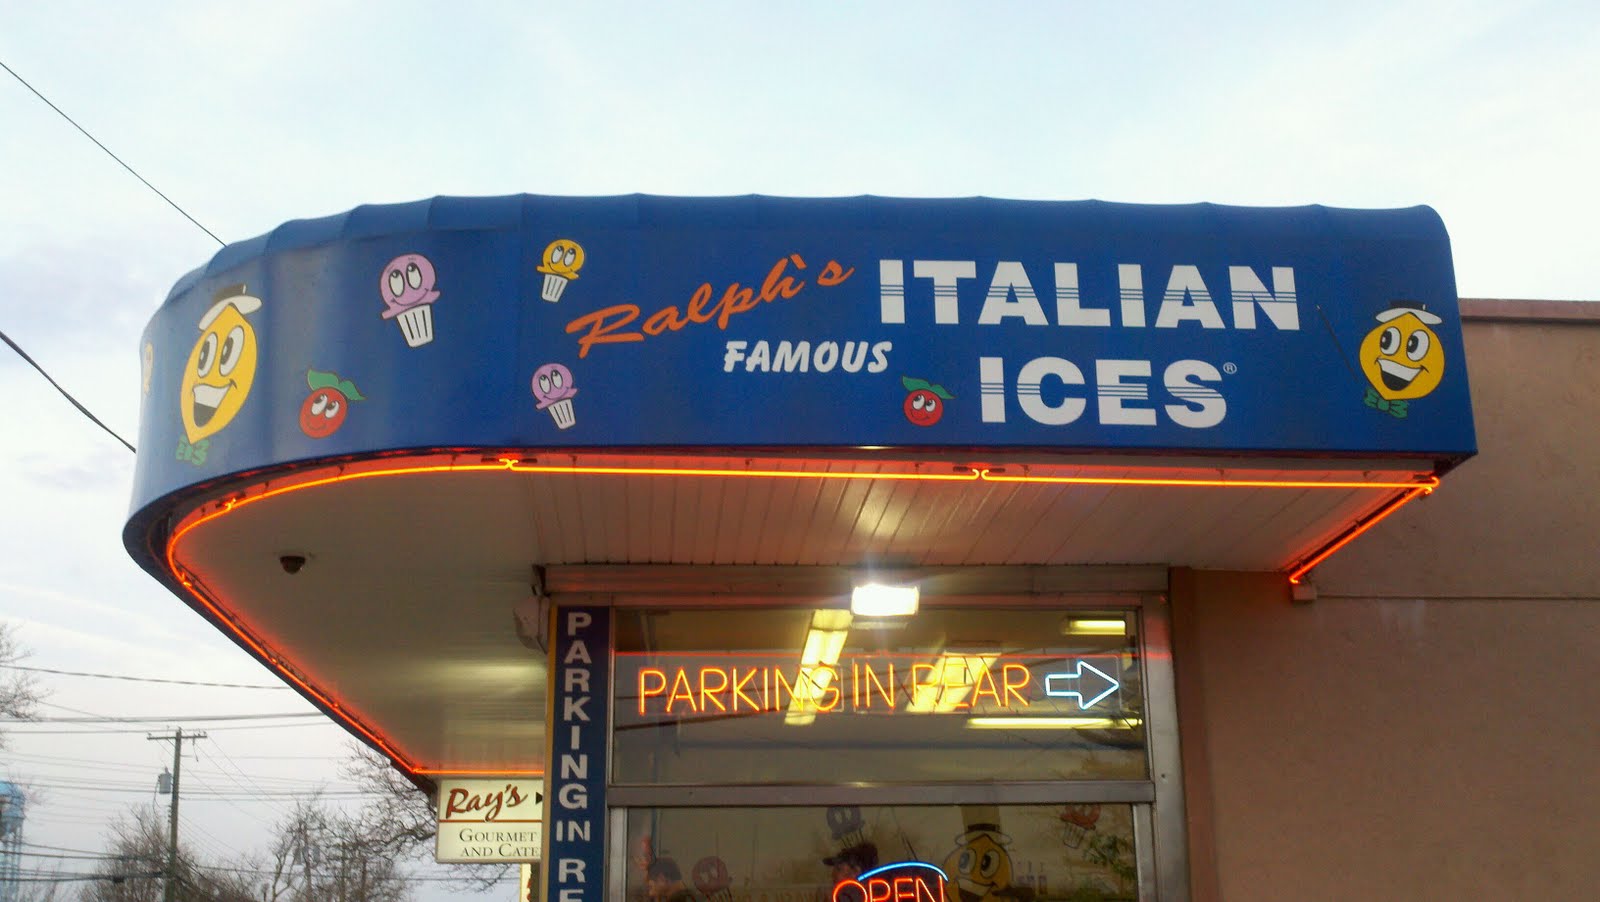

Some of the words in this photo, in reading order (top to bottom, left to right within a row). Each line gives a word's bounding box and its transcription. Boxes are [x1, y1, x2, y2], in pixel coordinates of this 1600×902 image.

[879, 259, 1300, 331] ITALIAN
[723, 340, 893, 374] FAMOUS
[638, 665, 840, 714] PARKING
[852, 662, 896, 708] IN
[911, 663, 1031, 708] REAR
[558, 612, 593, 810] PARKING
[445, 783, 529, 822] Ray's
[459, 828, 537, 843] GOURMET
[556, 820, 591, 842] IN
[460, 846, 493, 857] AND
[498, 843, 541, 858] CATE
[832, 874, 945, 902] OPEN
